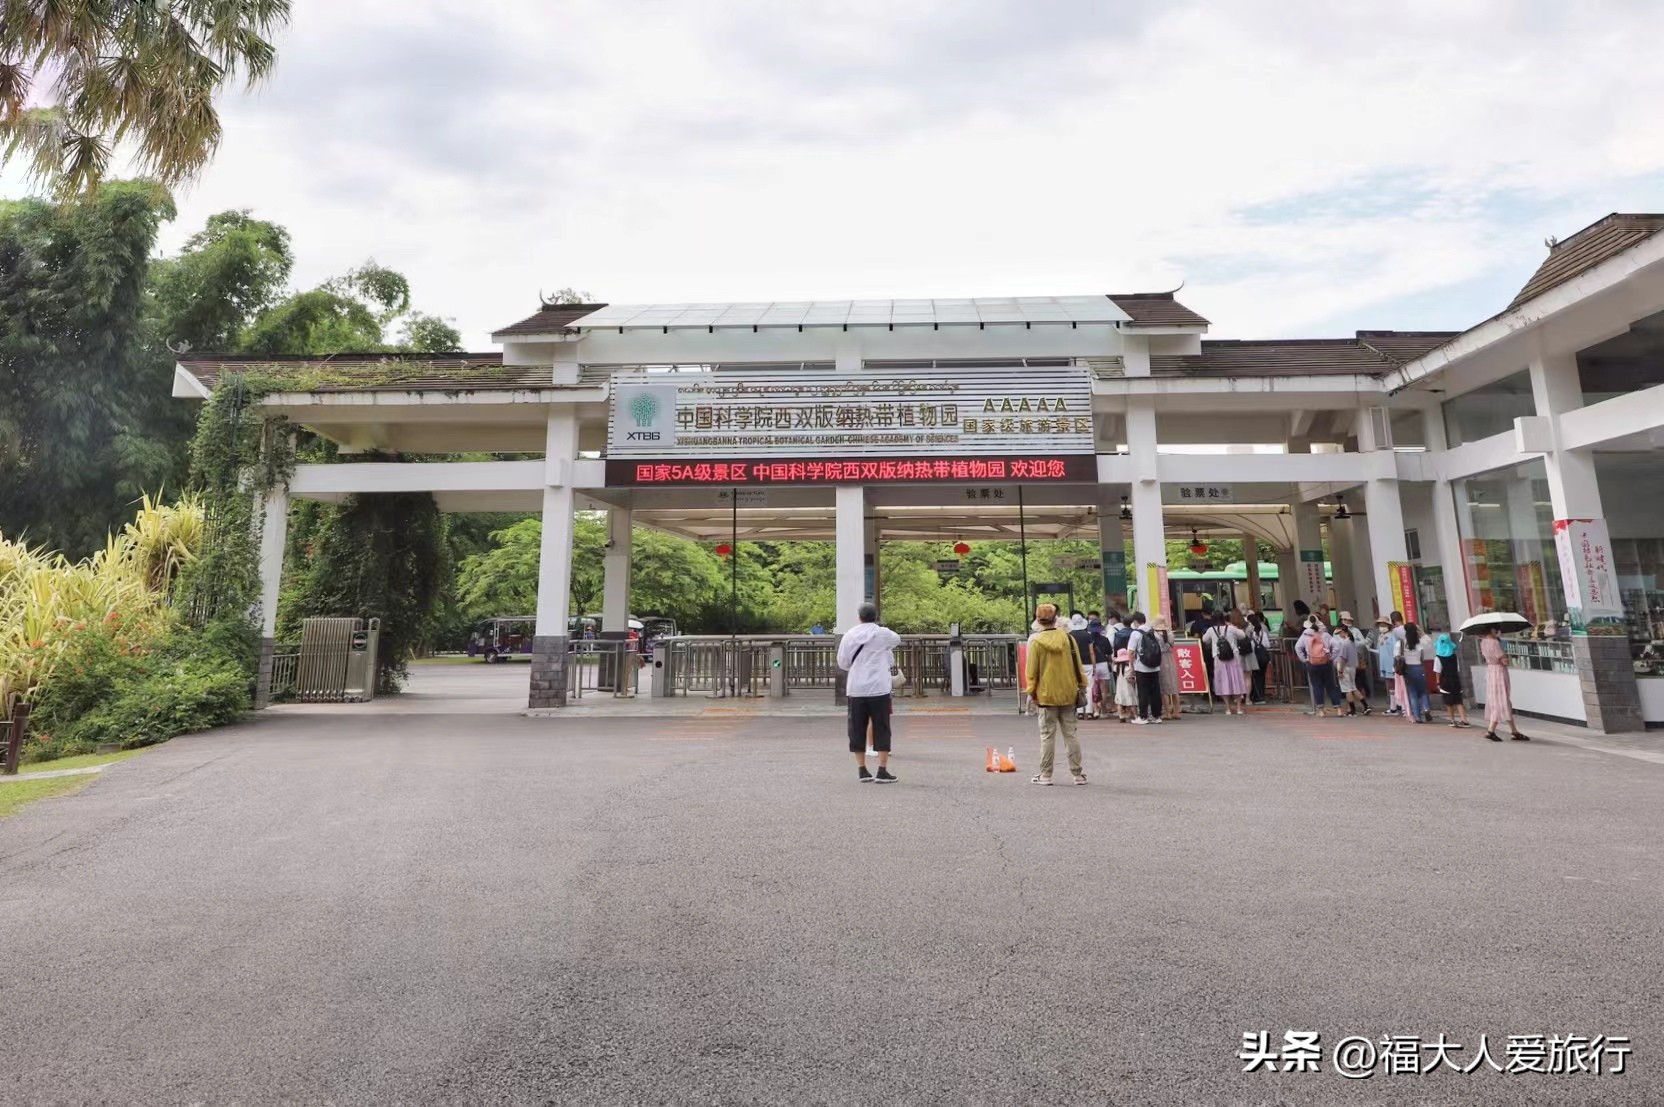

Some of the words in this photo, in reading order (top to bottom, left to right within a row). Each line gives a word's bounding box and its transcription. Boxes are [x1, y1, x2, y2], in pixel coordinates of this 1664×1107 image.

[983, 397, 1068, 413] AAAAA
[677, 402, 958, 430] 中国科学院西双版纳热带植物园
[963, 417, 1089, 434] 国家级旅游景区
[739, 436, 772, 446] TROPICAL
[775, 435, 814, 445] BOTANICAL
[816, 435, 844, 445] GARDEN
[916, 434, 924, 443] OF
[636, 463, 747, 481] 国家5A级景区
[753, 460, 1005, 481] 中国科学院西双版纳热带植物园
[1011, 459, 1066, 478] 欢迎您
[1180, 487, 1219, 498] 验票处
[1176, 648, 1195, 689] 散客入口
